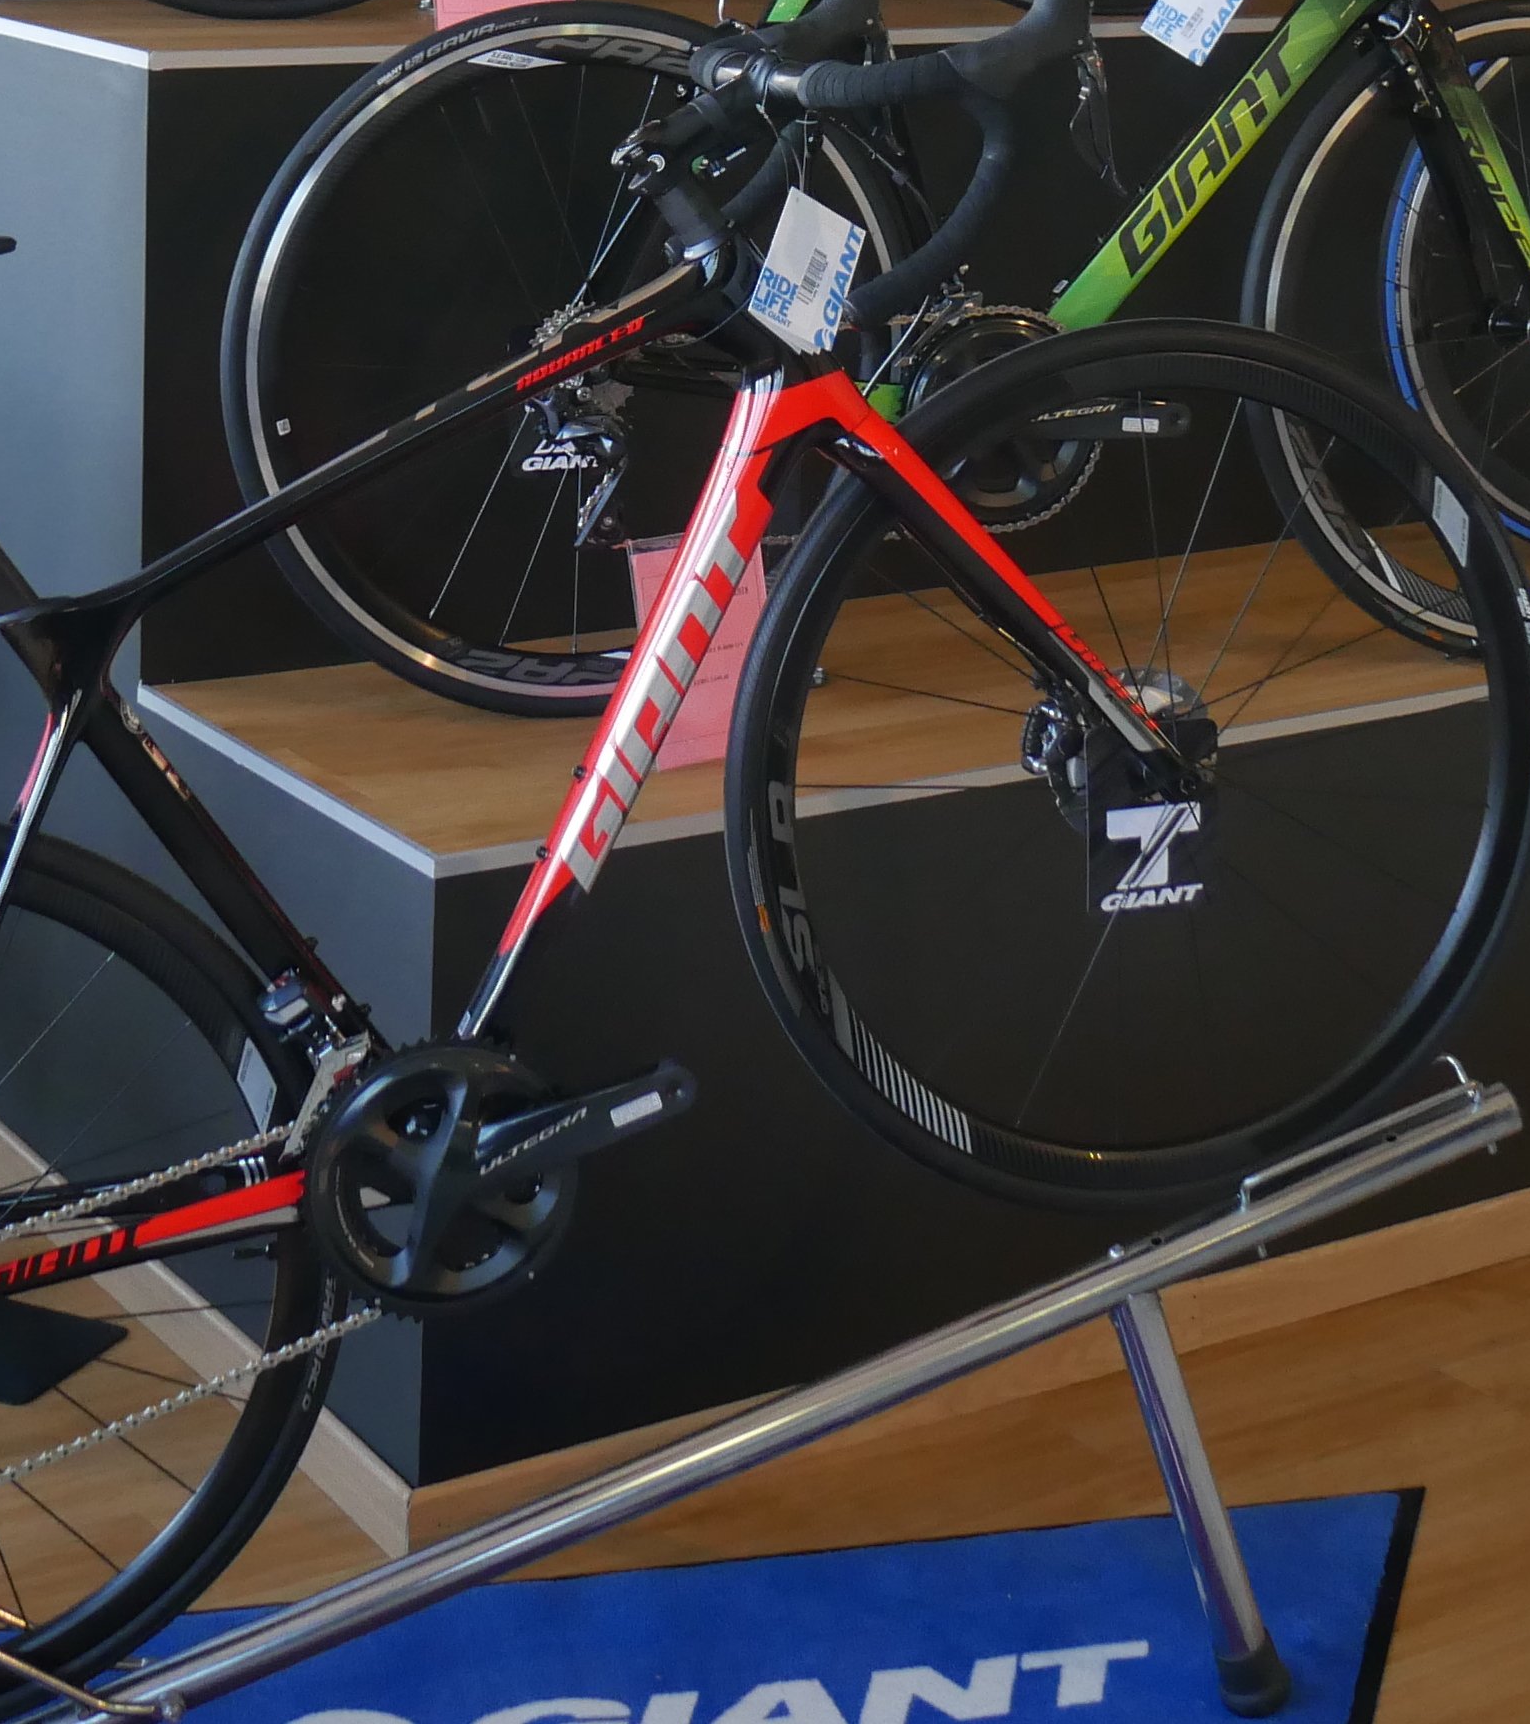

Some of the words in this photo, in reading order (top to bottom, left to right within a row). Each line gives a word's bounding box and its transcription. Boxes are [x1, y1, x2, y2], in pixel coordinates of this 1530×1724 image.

[426, 22, 497, 59] GAVIA
[1154, 0, 1188, 28] RIDE
[1117, 31, 1298, 279] GIANT
[754, 285, 793, 318] LIFE
[823, 224, 862, 327] GIANT
[515, 316, 645, 391] ADVANCED
[560, 482, 749, 893] GIANT
[768, 780, 817, 976] SLR
[1099, 882, 1205, 912] GIANT
[477, 1106, 589, 1176] ULTEGRA
